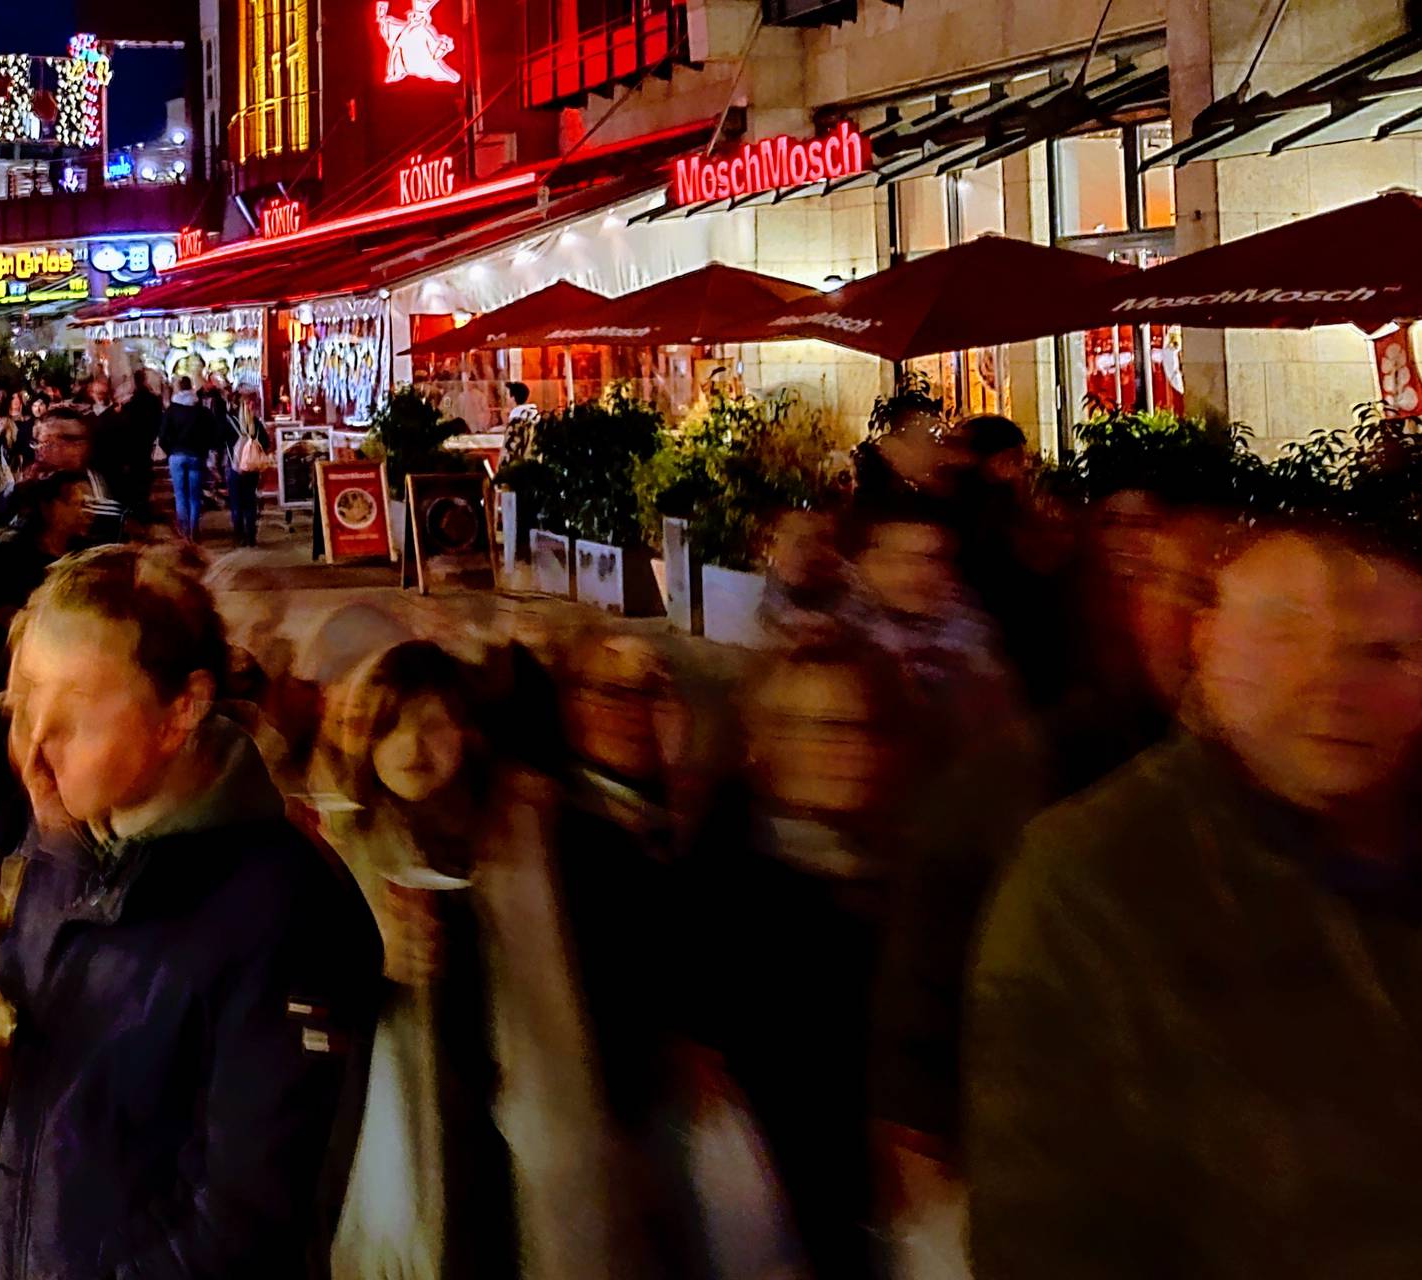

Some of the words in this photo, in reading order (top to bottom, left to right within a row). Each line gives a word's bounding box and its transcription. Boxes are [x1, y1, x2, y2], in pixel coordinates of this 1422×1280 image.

[399, 155, 455, 205] KÖNIG
[676, 122, 863, 205] MoschMosch
[263, 200, 301, 239] KÖNIG
[15, 249, 74, 279] Carlos
[1110, 286, 1377, 312] MoschMosch
